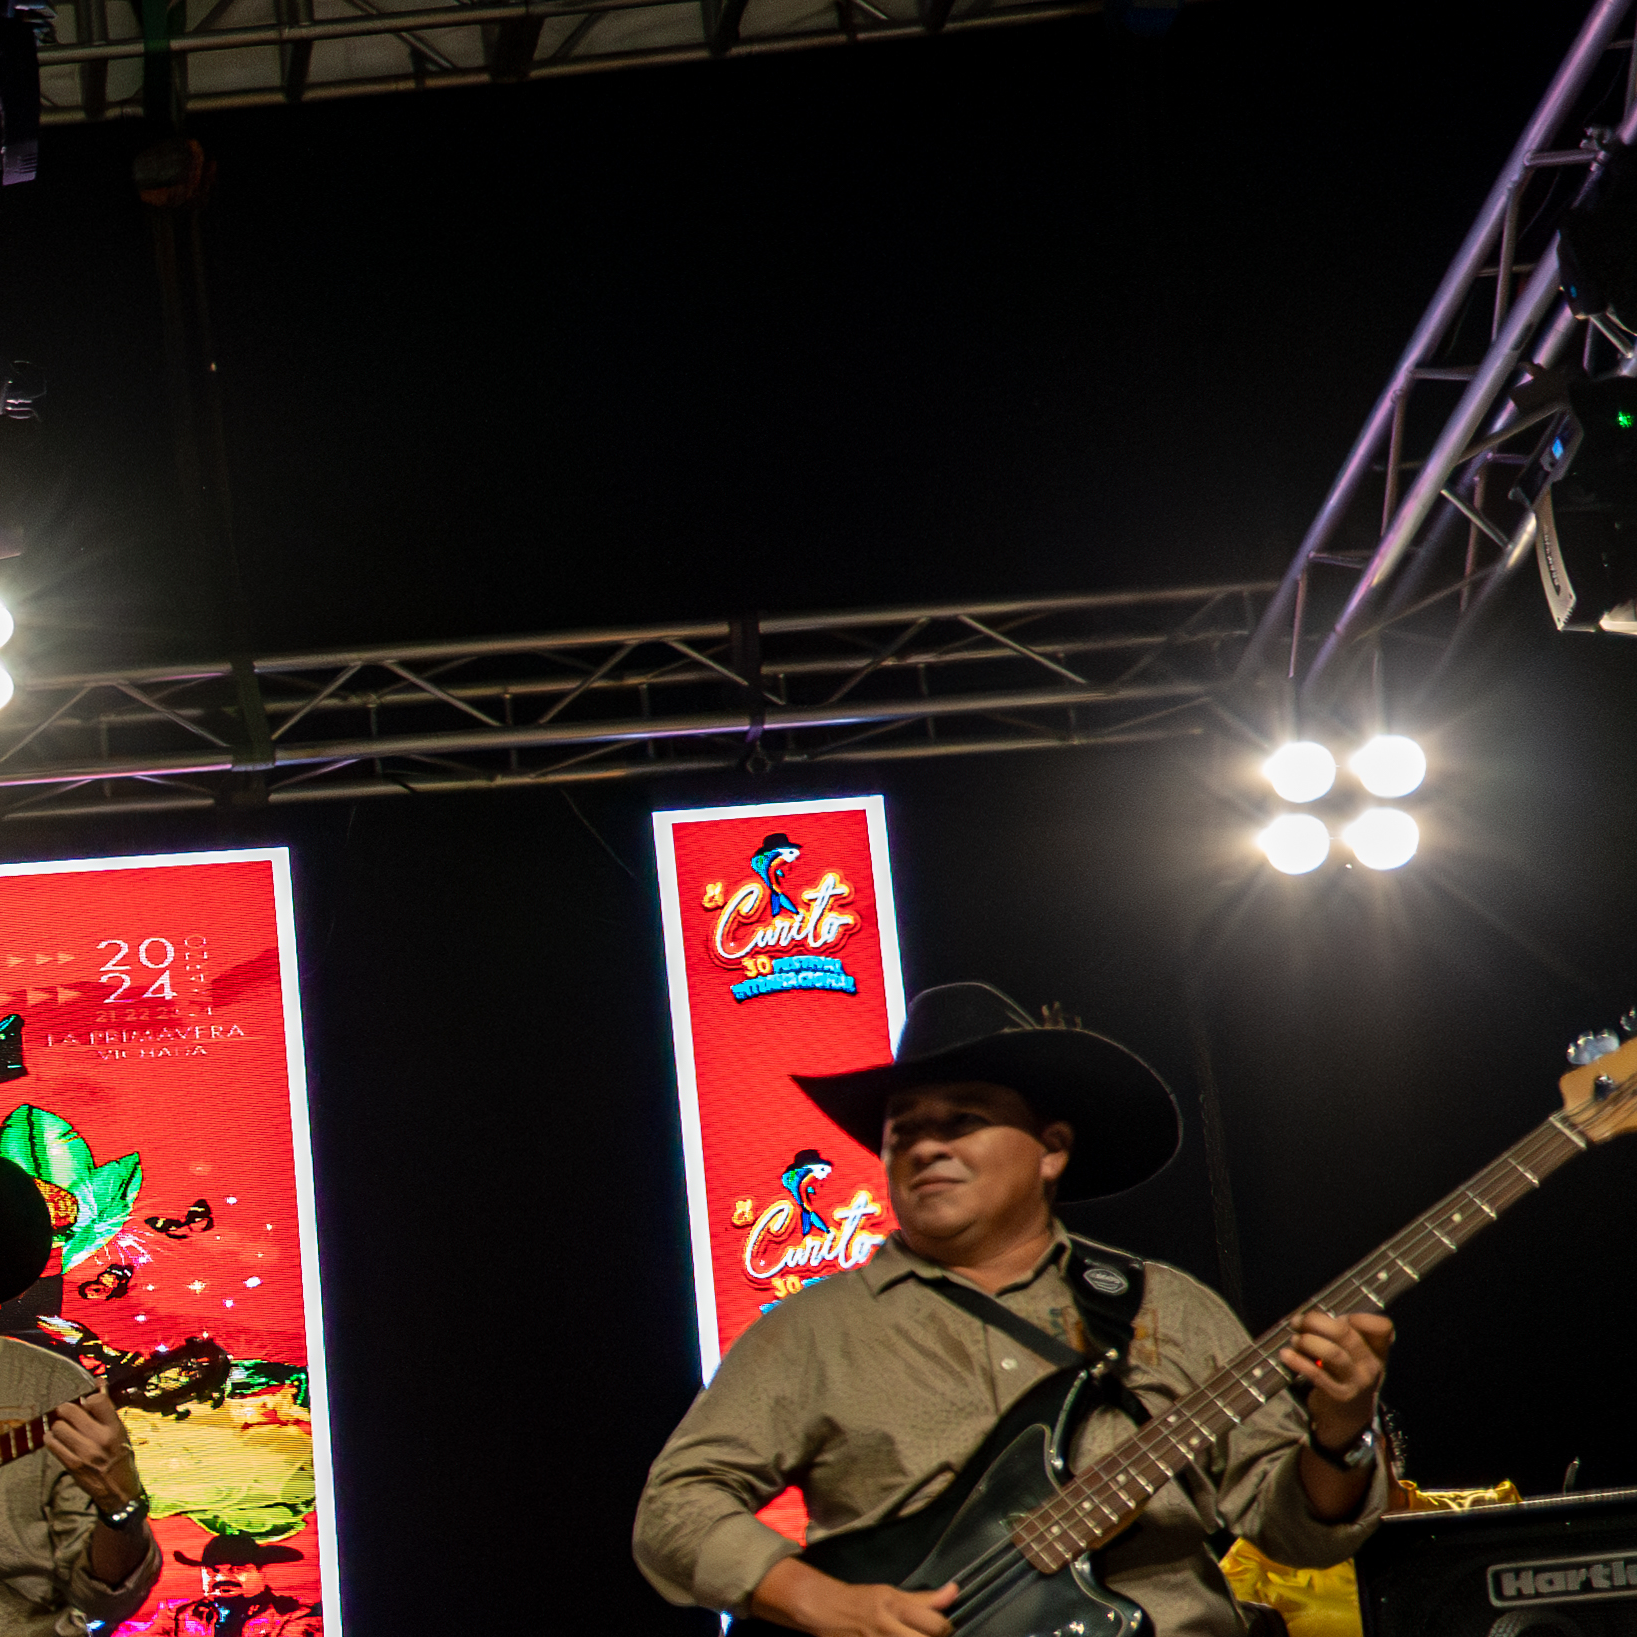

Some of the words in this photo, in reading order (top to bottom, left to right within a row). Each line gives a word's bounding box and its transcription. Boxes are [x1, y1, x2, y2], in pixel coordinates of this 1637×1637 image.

[714, 873, 855, 960] Curito
[96, 937, 175, 971] 20
[741, 954, 773, 978] 30
[98, 970, 178, 1003] 24
[89, 1024, 246, 1046] PRIMAVERA
[745, 1192, 886, 1279] Curito
